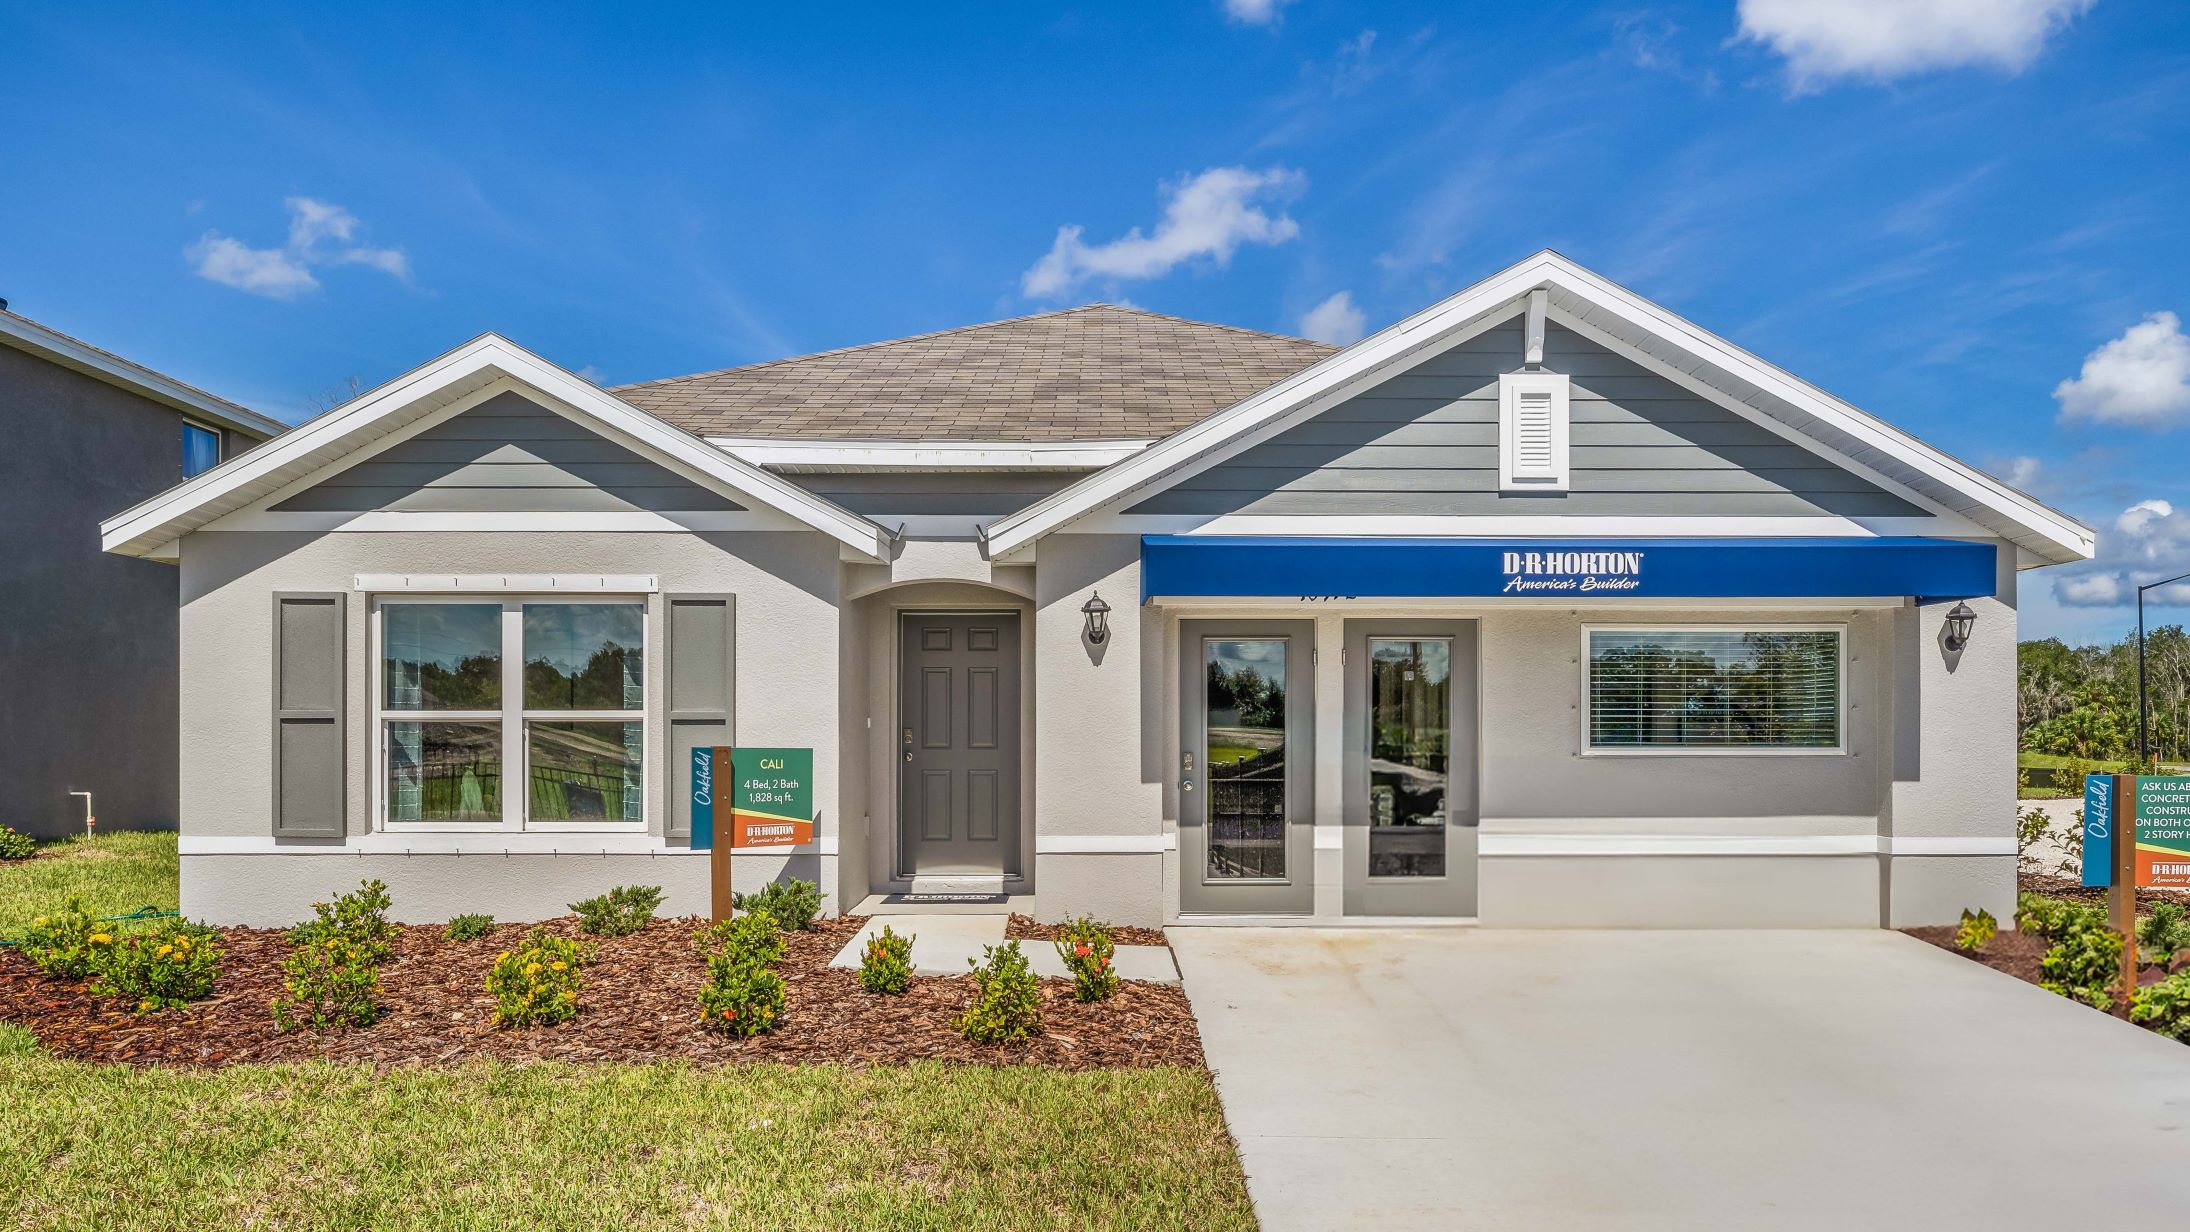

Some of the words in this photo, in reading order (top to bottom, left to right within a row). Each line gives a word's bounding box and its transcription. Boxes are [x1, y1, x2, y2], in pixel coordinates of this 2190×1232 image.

[1503, 575, 1577, 592] America's
[1579, 576, 1639, 592] Builder
[760, 758, 784, 769] CALI
[694, 752, 711, 805] Oakfield
[744, 780, 750, 789] 4
[752, 779, 771, 790] Bed,
[773, 780, 779, 789] 2
[780, 778, 799, 789] Bath
[2141, 782, 2161, 791] ASK
[2163, 782, 2177, 791] US
[749, 792, 772, 804] 1,828
[774, 795, 783, 805] sq
[784, 791, 794, 802] ft.
[2087, 779, 2110, 838] Oakfield
[2135, 818, 2151, 827] ON
[2153, 818, 2181, 827] BOTH
[2144, 830, 2150, 839] 2
[2152, 830, 2185, 839] STORY
